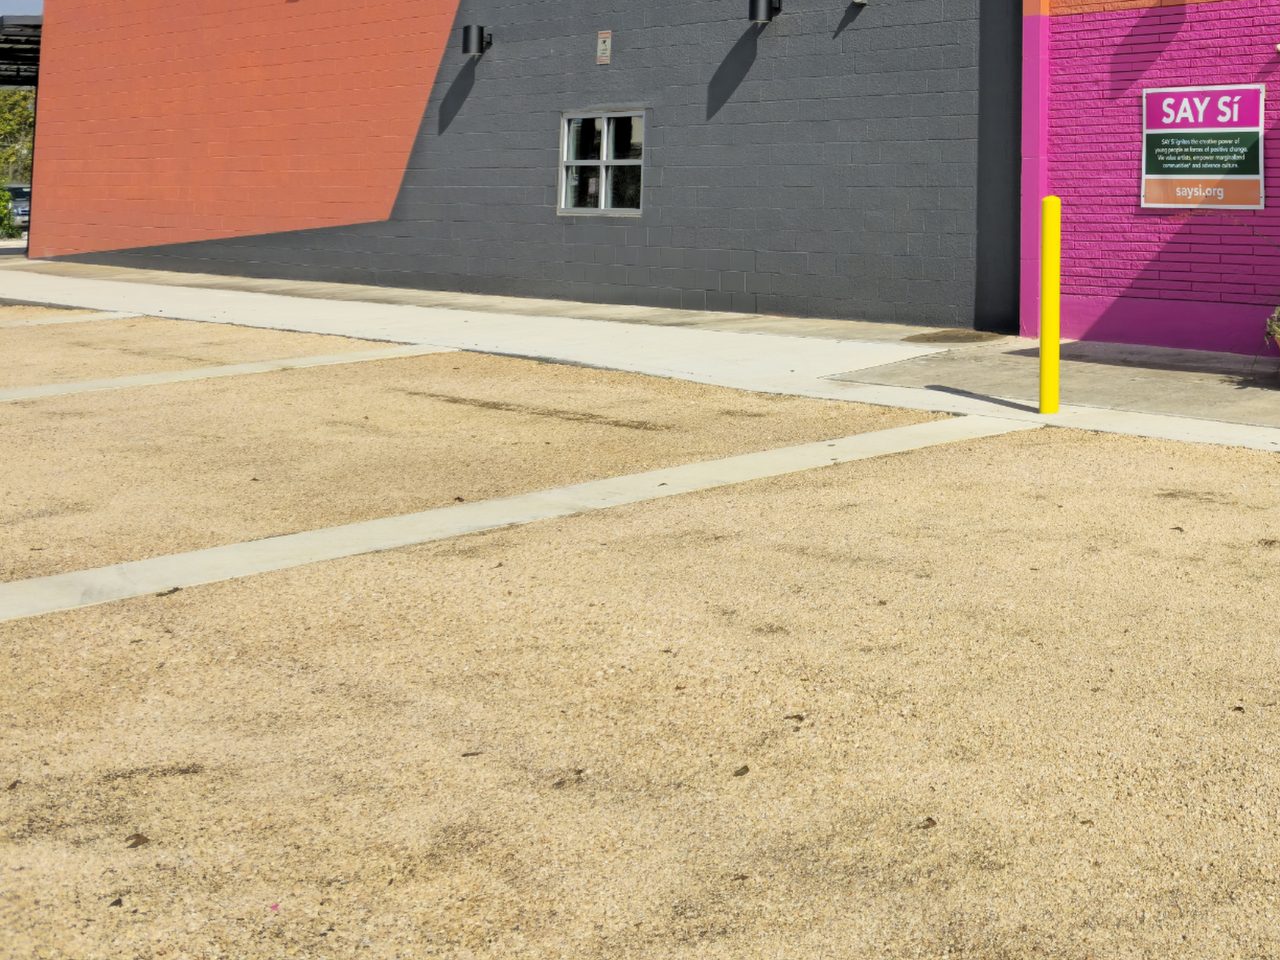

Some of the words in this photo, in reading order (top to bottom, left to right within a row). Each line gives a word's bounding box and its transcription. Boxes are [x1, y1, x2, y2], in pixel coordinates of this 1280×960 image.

[1161, 97, 1211, 124] SAY
[1217, 95, 1242, 123] Sí
[1234, 137, 1240, 145] of
[1155, 147, 1168, 155] young
[1168, 146, 1183, 155] people
[1210, 146, 1228, 154] positive
[1216, 153, 1246, 162] marginalized
[1175, 184, 1225, 200] saysi.org
